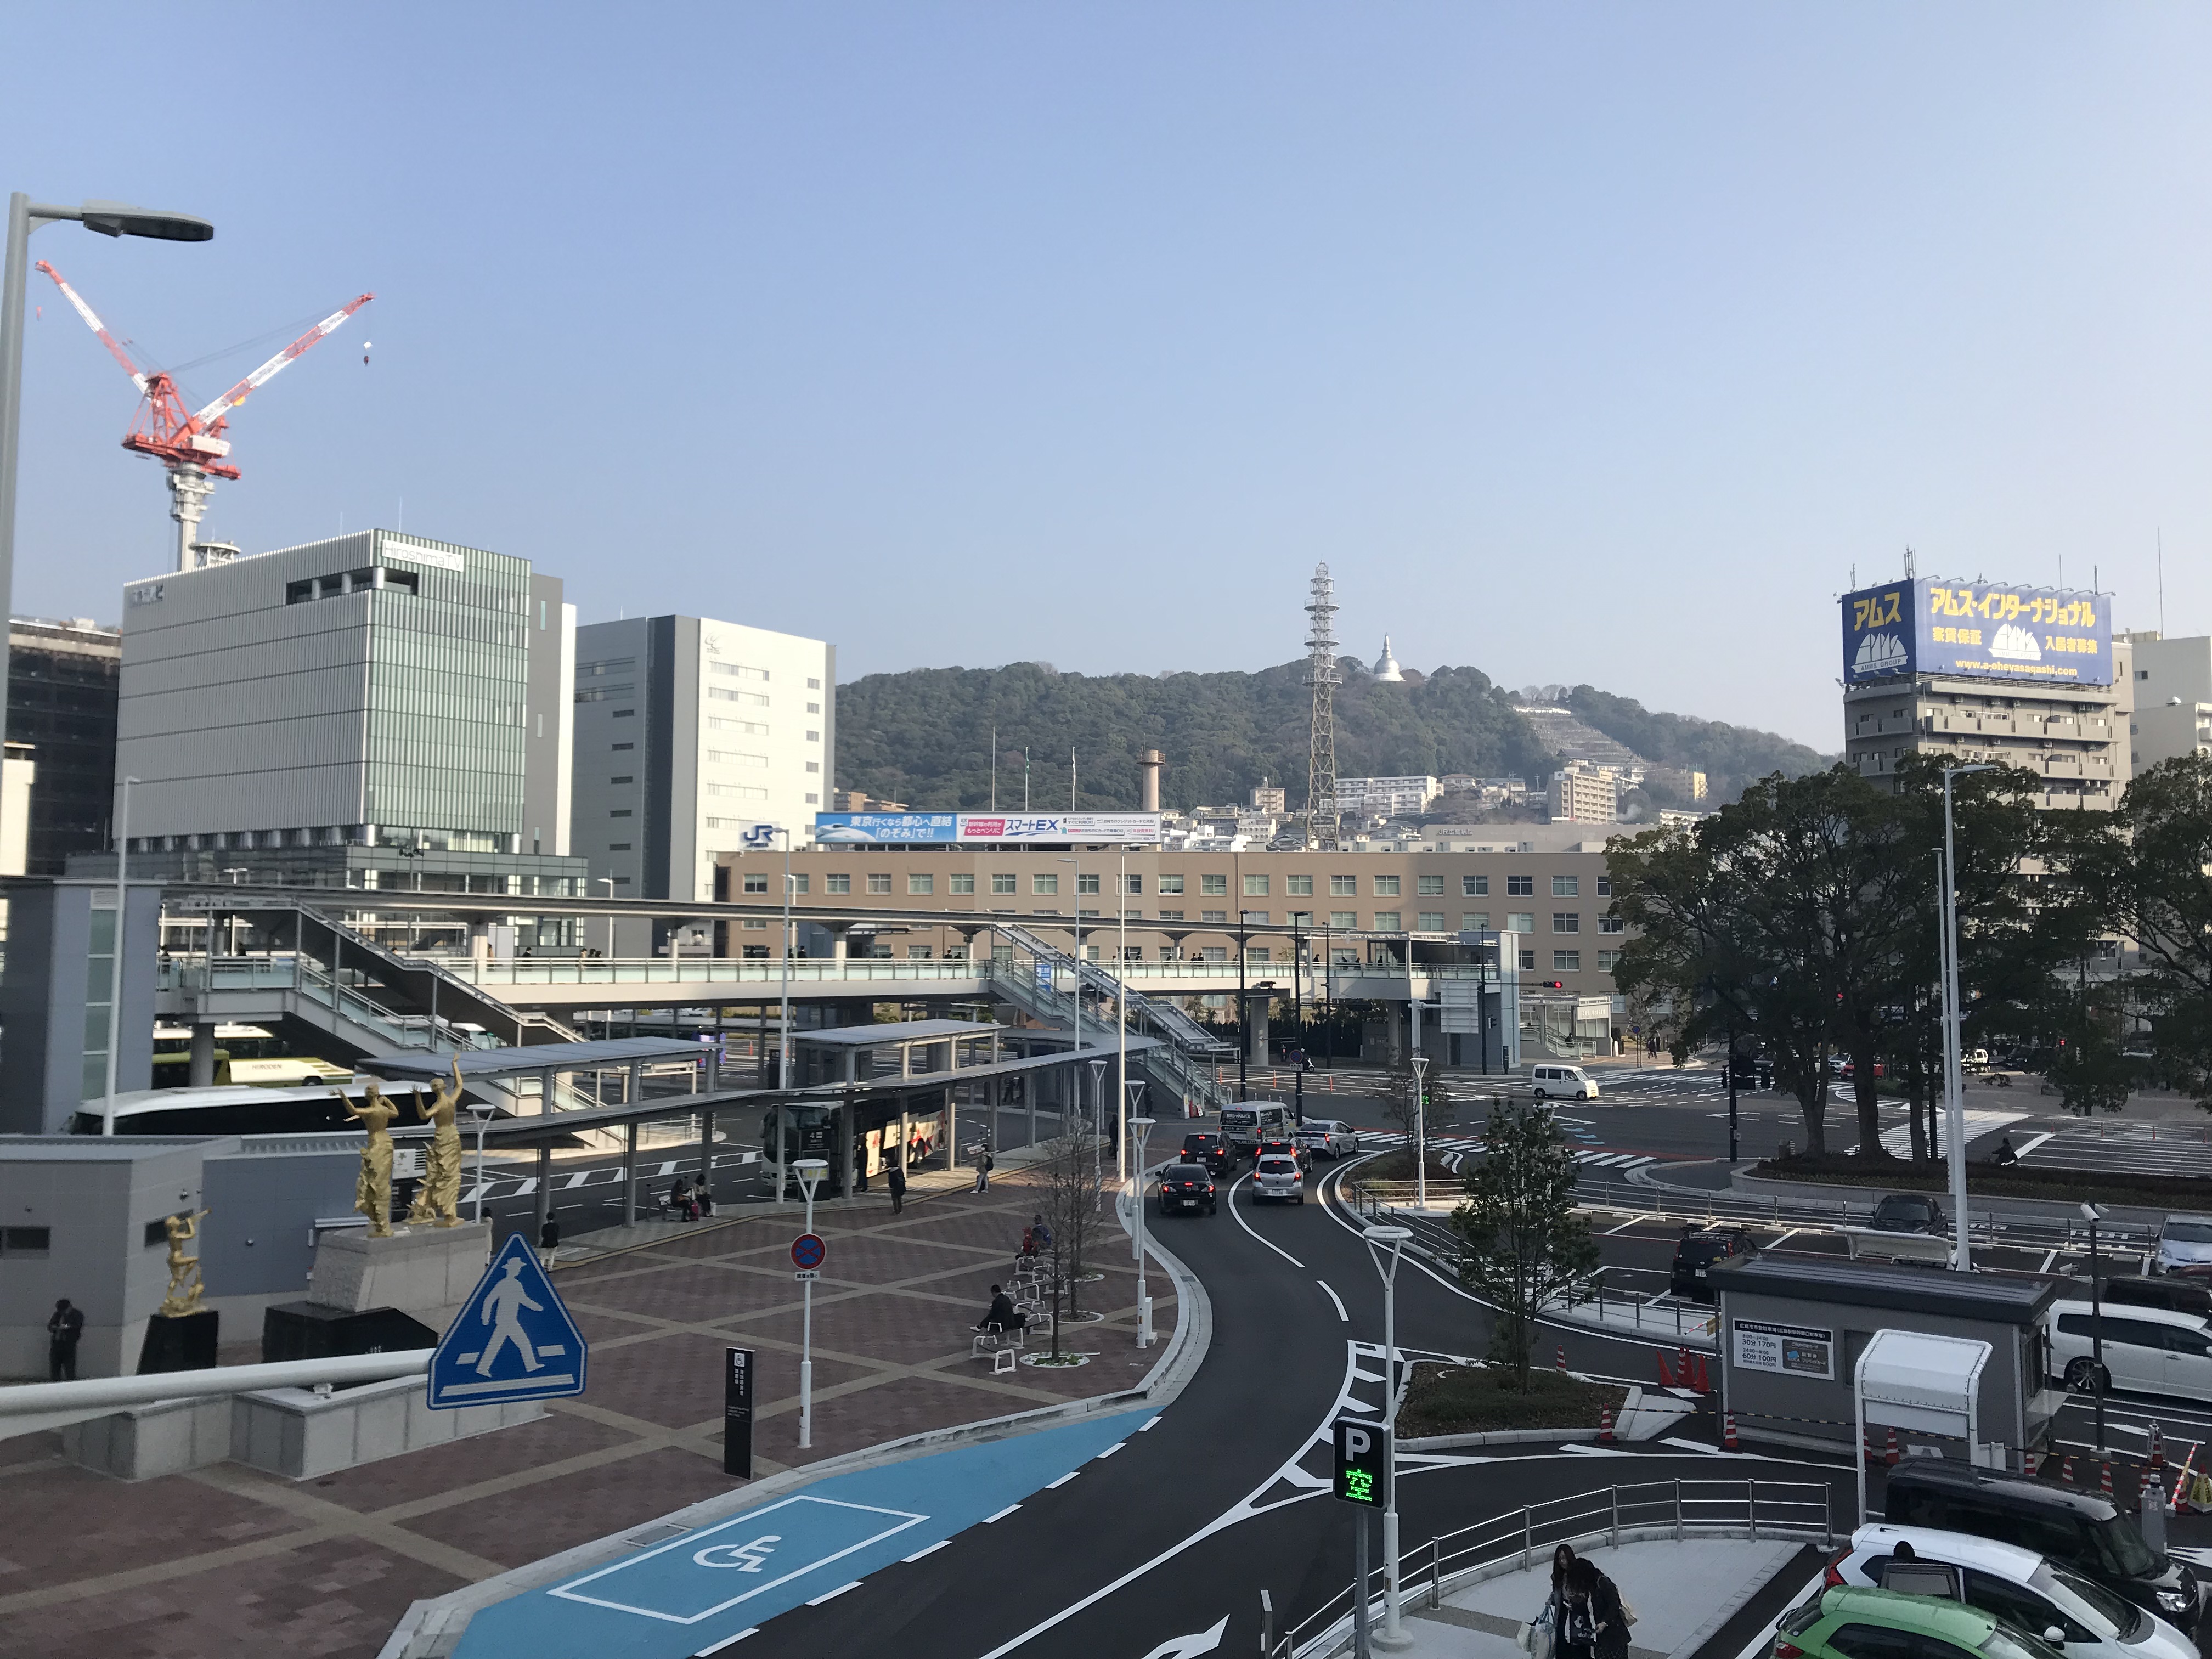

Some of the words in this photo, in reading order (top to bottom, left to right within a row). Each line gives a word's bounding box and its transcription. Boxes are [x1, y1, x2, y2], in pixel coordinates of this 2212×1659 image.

[384, 542, 462, 569] HiroshimaTV
[1854, 592, 1902, 631] アムス
[1931, 588, 2096, 628] アムス・インターナショナル
[1932, 627, 1982, 645] 家賃保証
[2045, 636, 2098, 654] 入居者募集
[1880, 658, 1901, 667] GROUP
[850, 816, 952, 827] 東京行くなら都心へ直結
[1005, 819, 1060, 831] スマートEX
[743, 825, 774, 842] JR
[1758, 1341, 1776, 1349] 170円
[1758, 1355, 1776, 1363] 100円
[1346, 1427, 1371, 1462] P
[1346, 1469, 1373, 1502] 空
